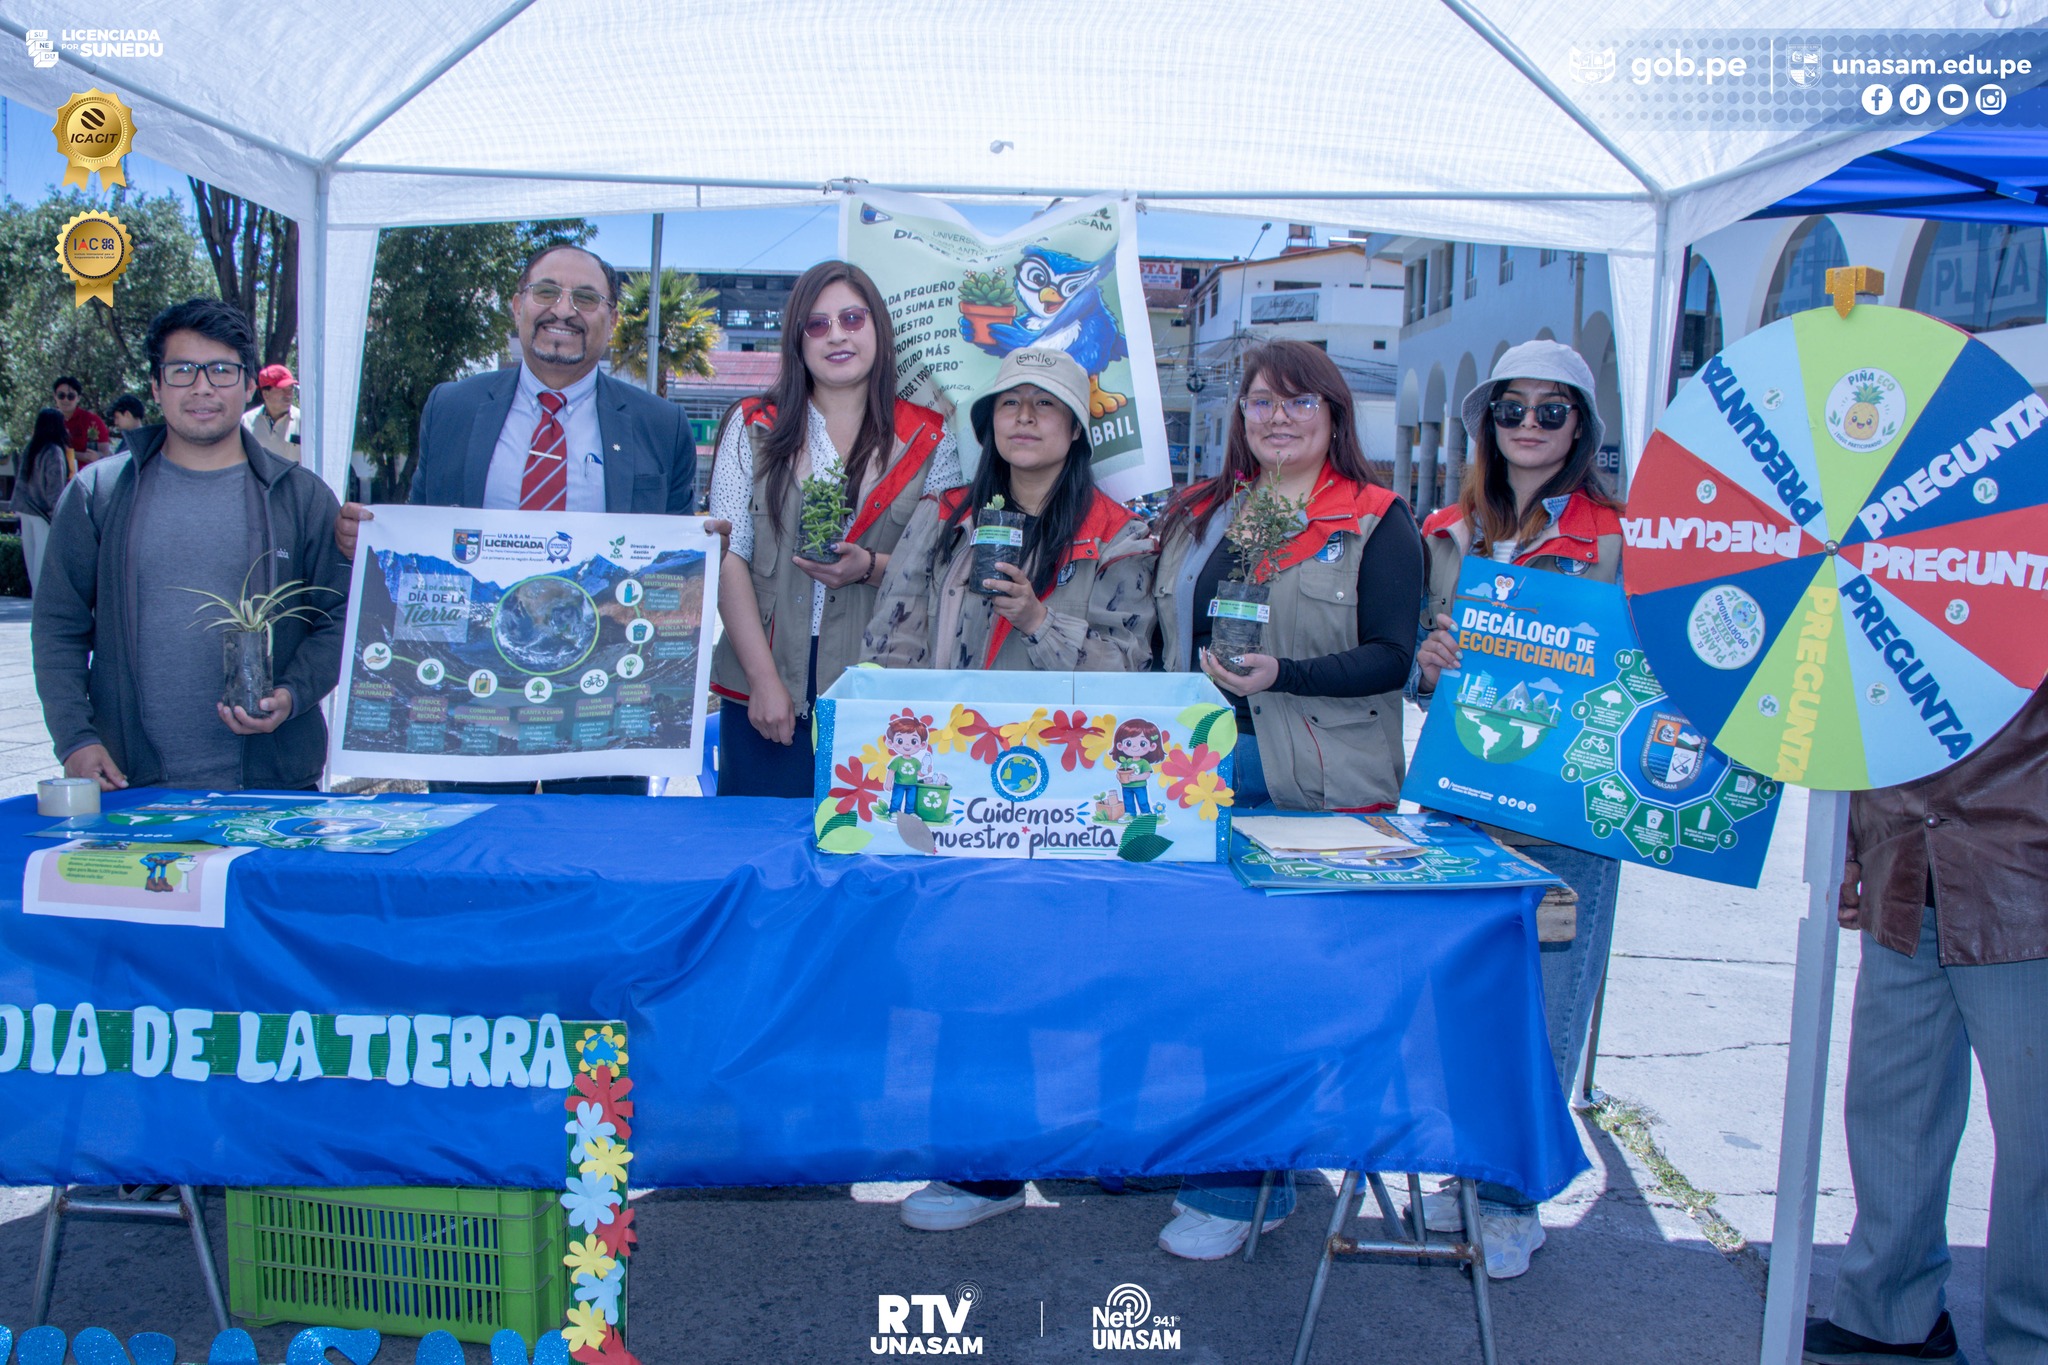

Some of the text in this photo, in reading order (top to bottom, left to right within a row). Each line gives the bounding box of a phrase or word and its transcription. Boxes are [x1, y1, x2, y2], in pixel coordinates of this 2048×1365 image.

[1139, 263, 1178, 275] STAL
[903, 280, 956, 300] PEQUEÑO
[905, 299, 935, 315] SUMA
[937, 296, 953, 308] EN
[934, 328, 957, 340] POR
[896, 344, 951, 379] FUTURO MÁS
[1847, 369, 1896, 392] PIÑA ECO
[1091, 415, 1135, 447] BRIL
[1701, 355, 1824, 528] PREGUNTA
[1857, 392, 2048, 541] PREGUNTA
[1977, 482, 1993, 500] 2
[484, 539, 545, 549] LICENCIADA
[1619, 516, 1802, 560] PREGUNTA
[1861, 541, 2048, 592] PREGUNT
[408, 590, 466, 604] DÍA DE LA
[403, 602, 462, 625] Tierra
[1715, 594, 1750, 649] OPORTUNIDAD
[1949, 602, 1964, 620] 3
[1461, 607, 1597, 656] DECÁLOGO DE
[1694, 613, 1727, 664] PLANETA
[1458, 630, 1596, 678] ECOEFICIENCIA
[1619, 653, 1632, 665] 10
[1838, 573, 1974, 761] PREGUNTA
[1771, 585, 1839, 782] PREGUNTA
[1577, 705, 1586, 716] 9
[1566, 767, 1576, 777] 8
[1651, 778, 1678, 790] UNASAM
[1764, 785, 1772, 796] 4
[966, 797, 1075, 825] Cuidemos
[1599, 823, 1607, 834] 7
[1723, 833, 1732, 844] 5
[931, 824, 1118, 859] nuestro planeta
[1658, 850, 1668, 860] 6
[0, 1002, 573, 1089] DIA DE LA TIERRA
